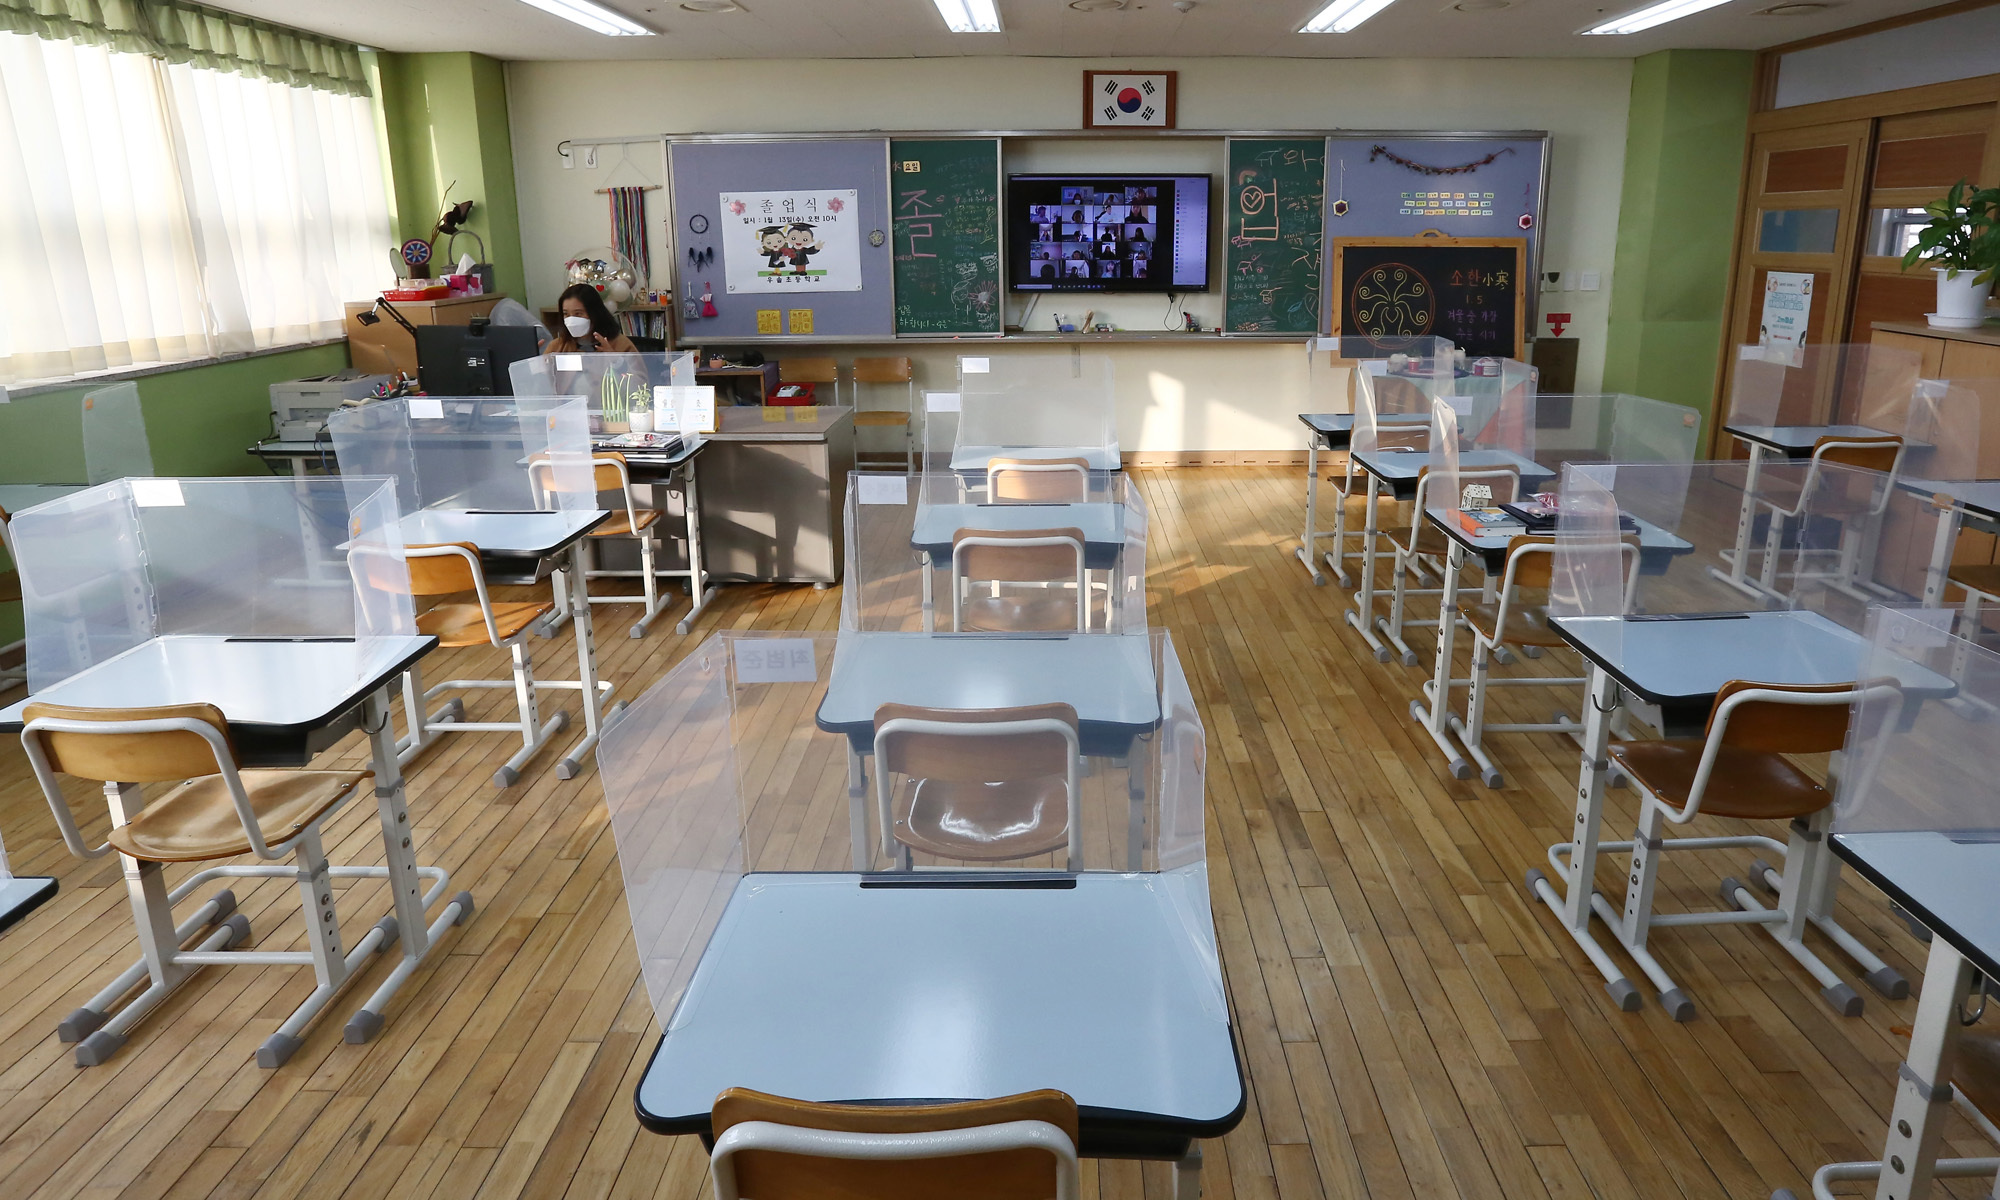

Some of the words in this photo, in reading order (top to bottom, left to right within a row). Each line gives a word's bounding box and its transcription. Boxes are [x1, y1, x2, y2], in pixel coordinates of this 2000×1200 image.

[905, 162, 918, 172] 요일
[808, 215, 820, 223] 오전
[1448, 309, 1464, 323] 겨울
